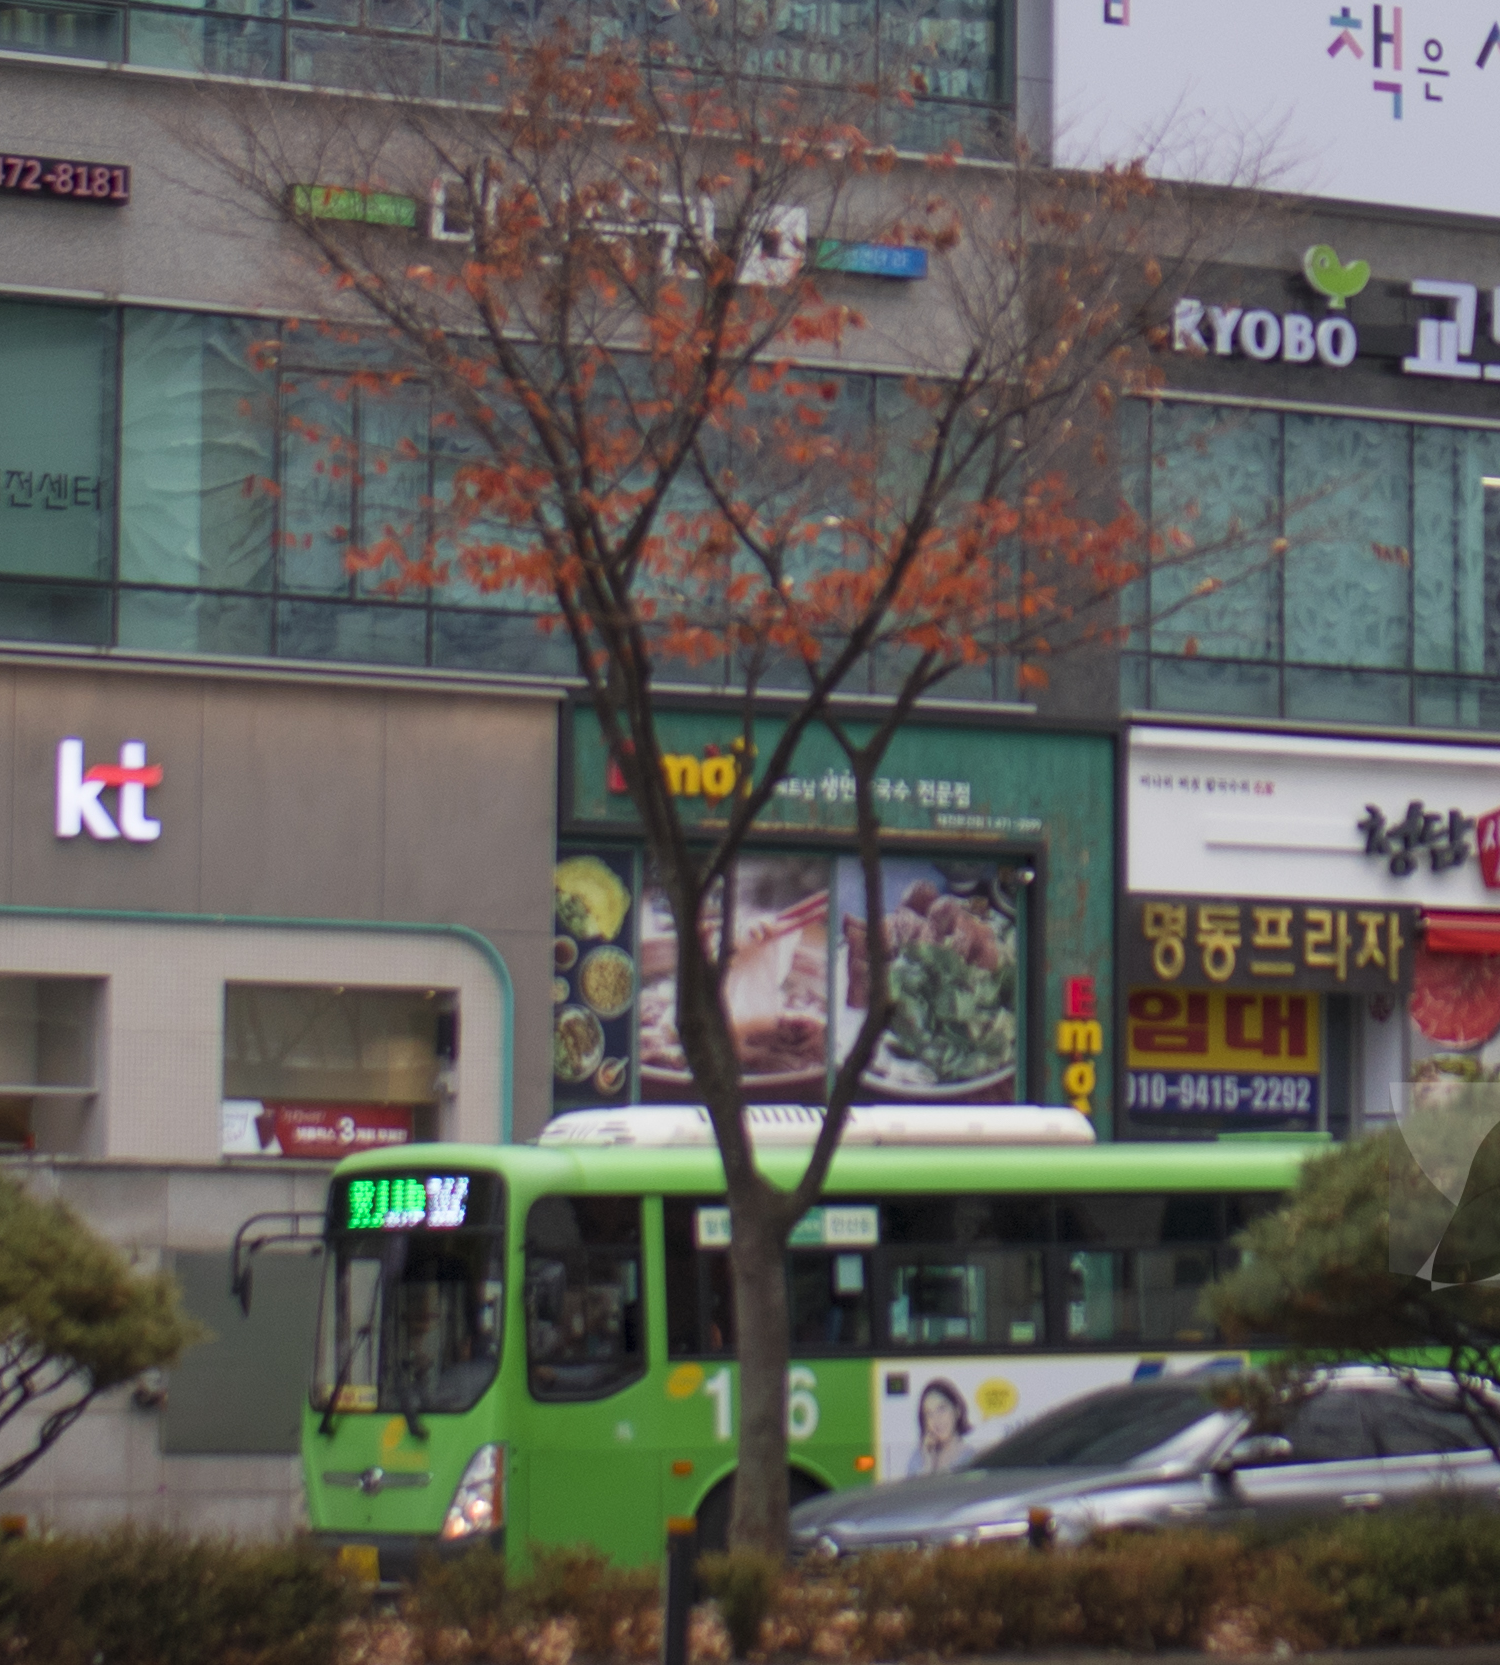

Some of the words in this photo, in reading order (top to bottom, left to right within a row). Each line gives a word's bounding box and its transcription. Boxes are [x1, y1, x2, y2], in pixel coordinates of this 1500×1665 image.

[1326, 2, 1452, 121] 책은
[55, 738, 163, 842] kt
[1357, 798, 1475, 880] 청담
[1143, 903, 1405, 984] 명동프라자
[1128, 988, 1304, 1061] 임대
